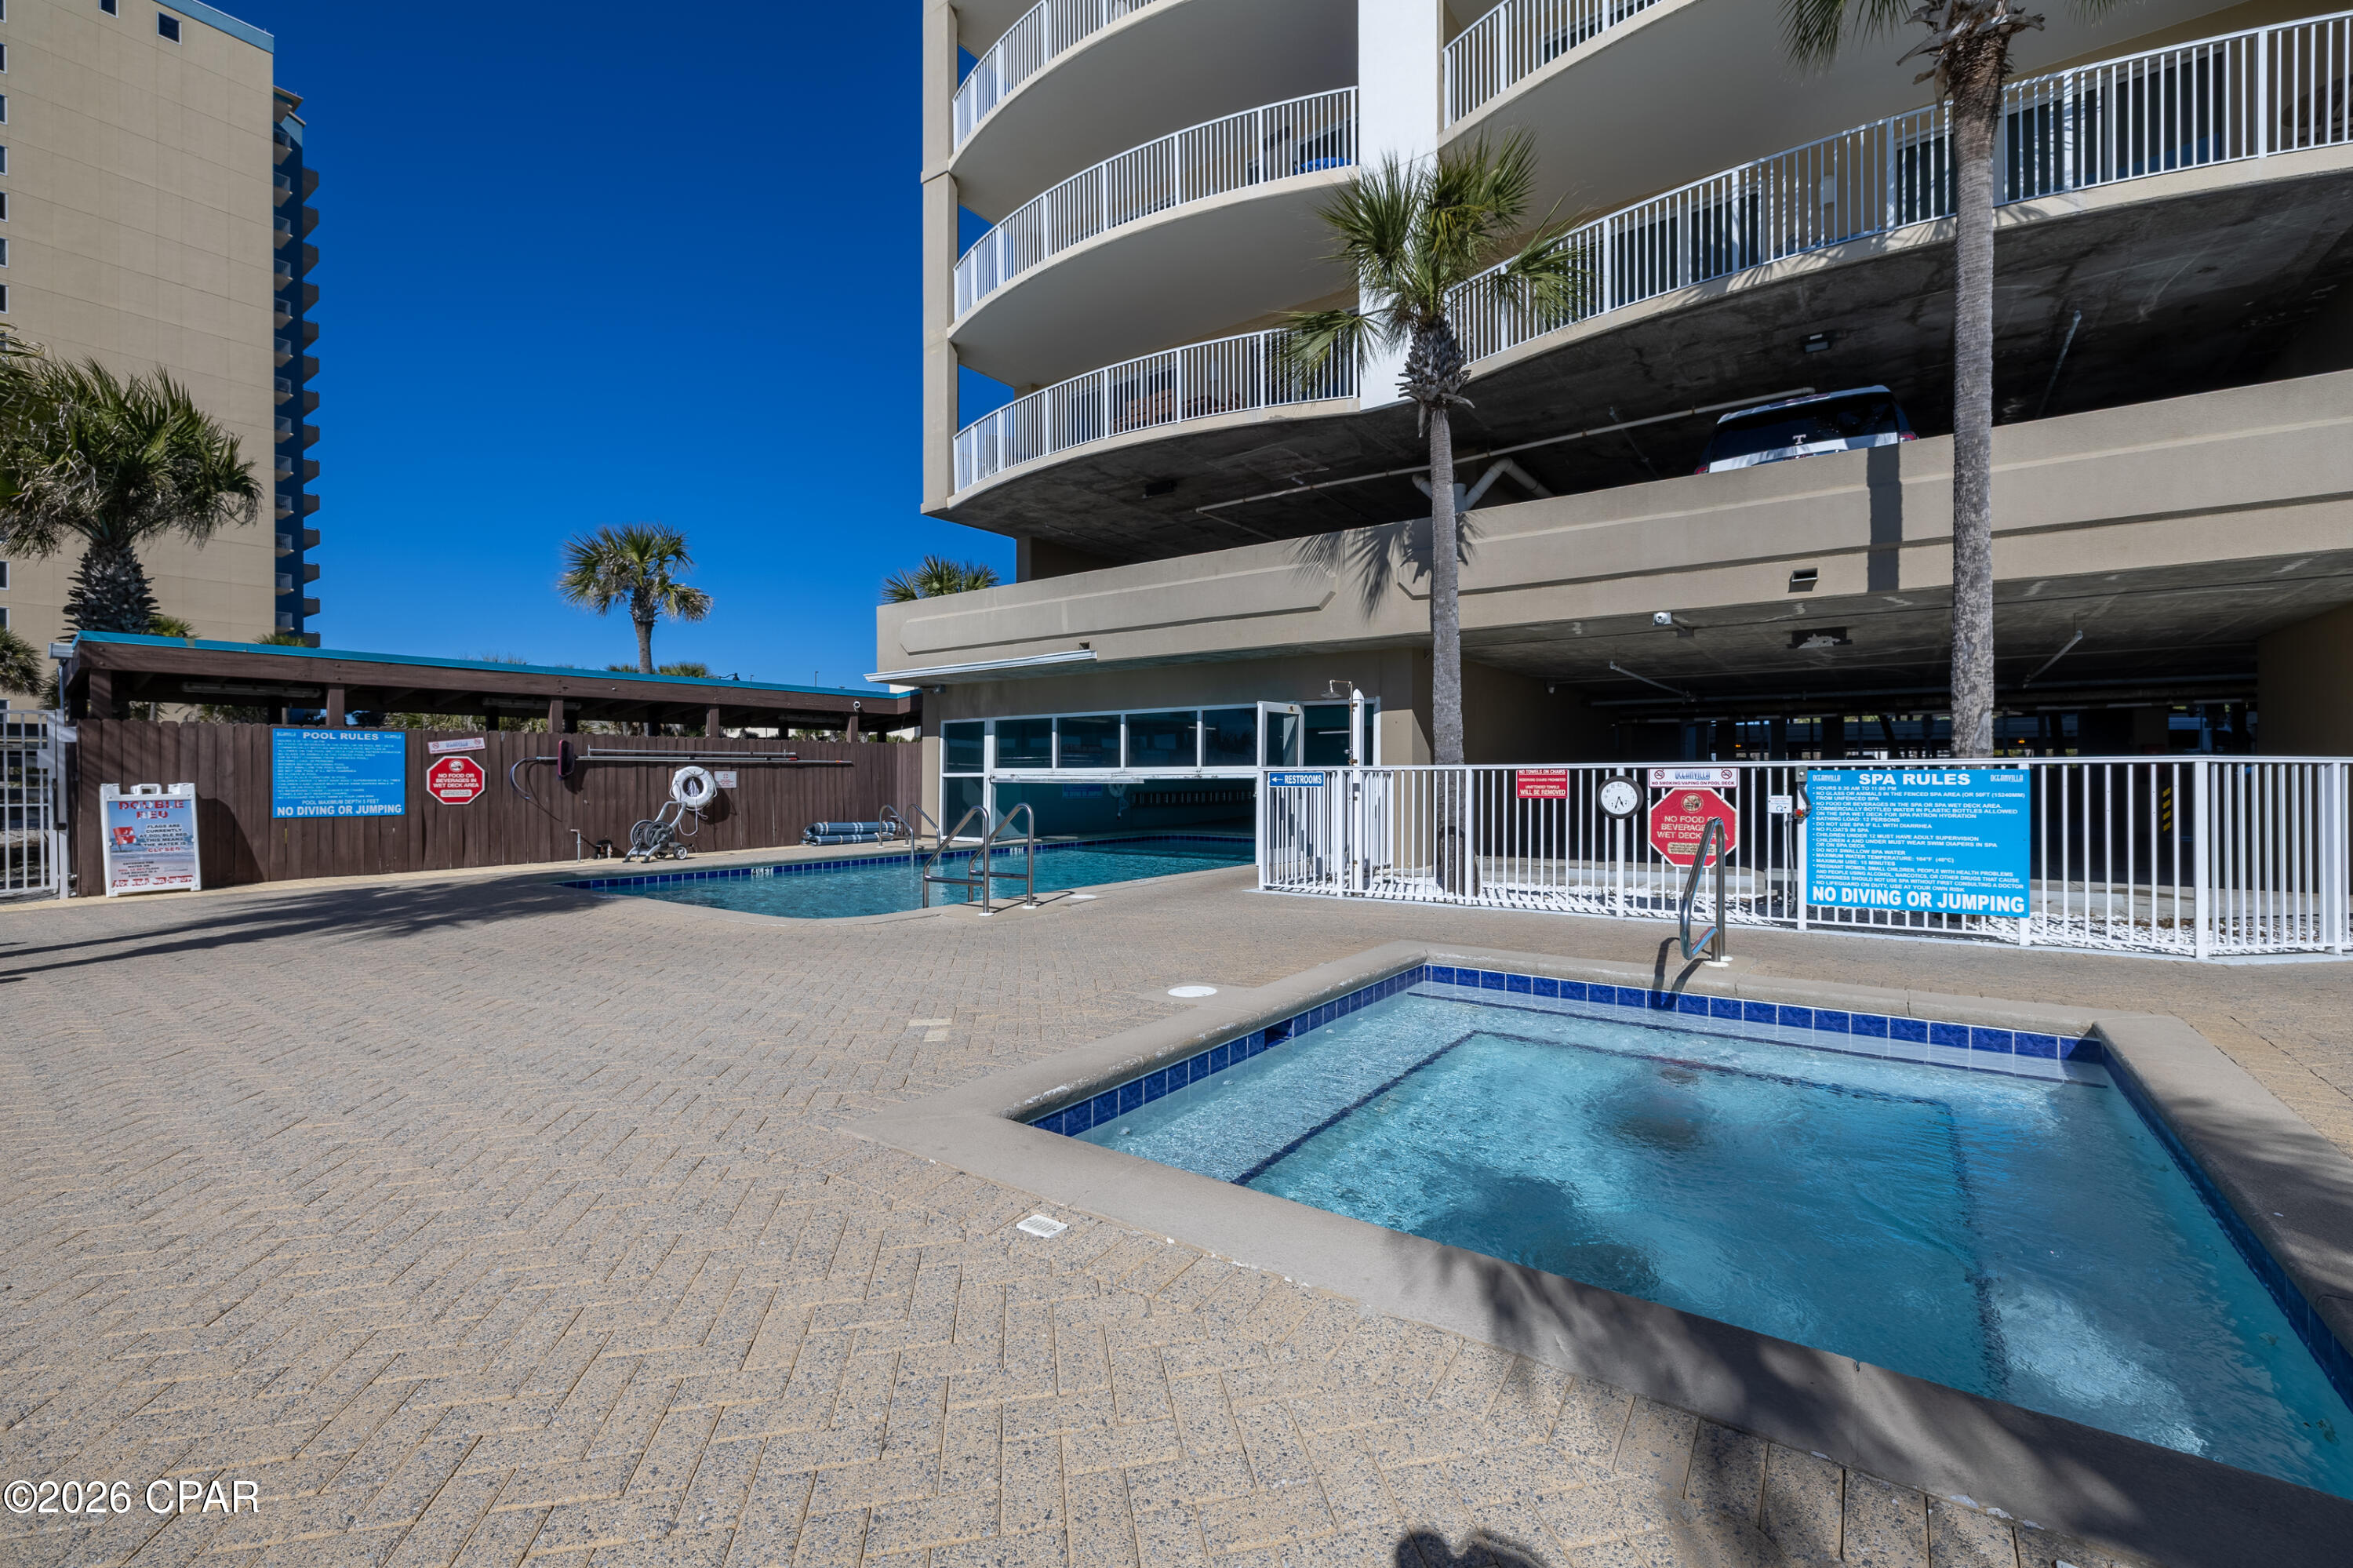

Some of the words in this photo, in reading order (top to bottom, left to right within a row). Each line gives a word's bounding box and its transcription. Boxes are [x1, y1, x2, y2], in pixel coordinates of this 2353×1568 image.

[1793, 435, 1806, 445] T
[1285, 775, 1322, 784] RESTROOMS
[1859, 773, 1896, 784] SPA
[1903, 773, 1970, 784] RULES
[277, 807, 293, 816] NO
[297, 806, 334, 815] DIVING
[338, 806, 352, 814] OR
[356, 804, 402, 814] JUMPING
[1813, 886, 1835, 901] NO
[1842, 887, 1900, 905] DIVING
[1907, 890, 1932, 907] OR
[1937, 892, 2024, 912] JUMPING
